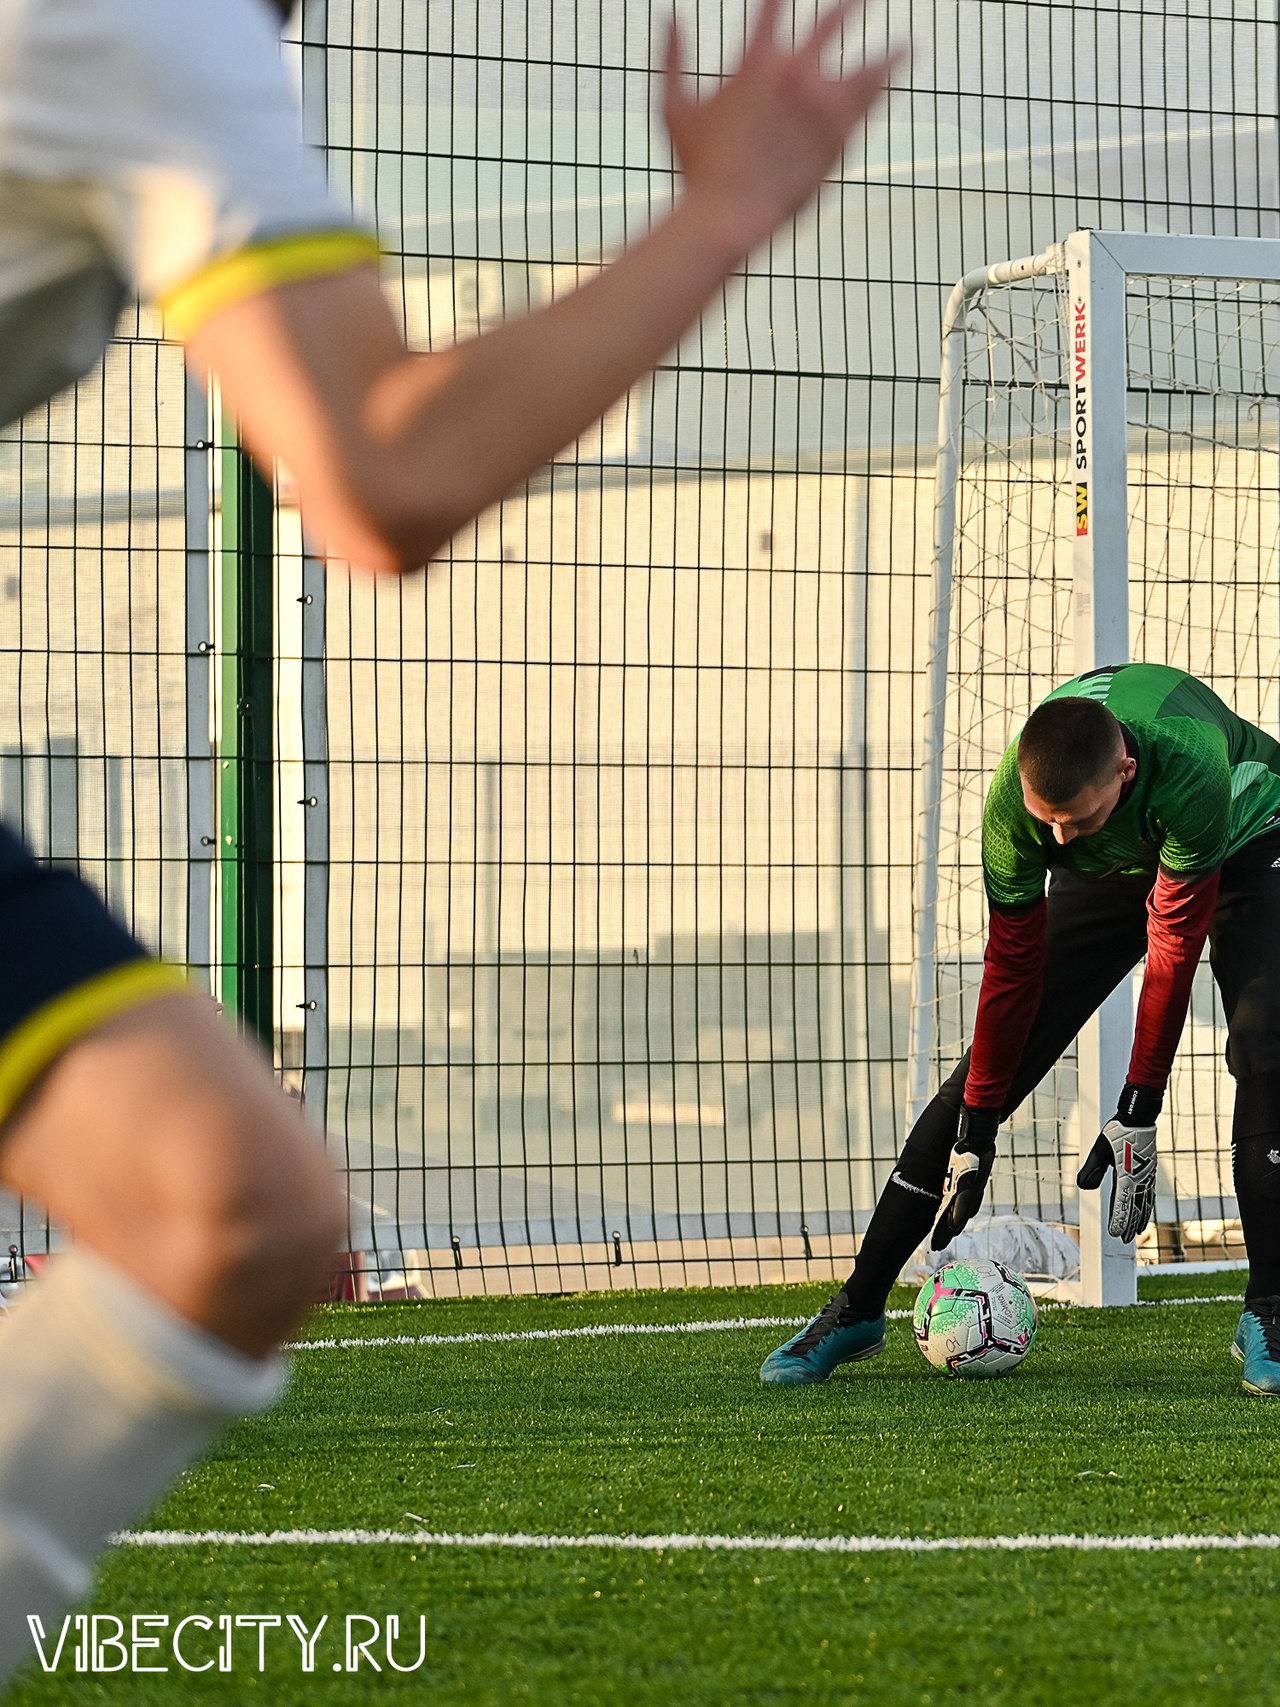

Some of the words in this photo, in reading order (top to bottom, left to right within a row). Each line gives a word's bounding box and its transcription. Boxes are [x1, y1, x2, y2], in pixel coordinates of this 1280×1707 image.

[1075, 302, 1087, 469] SPORTWERK
[1077, 483, 1088, 531] SW
[1119, 1186, 1130, 1230] ALPHA
